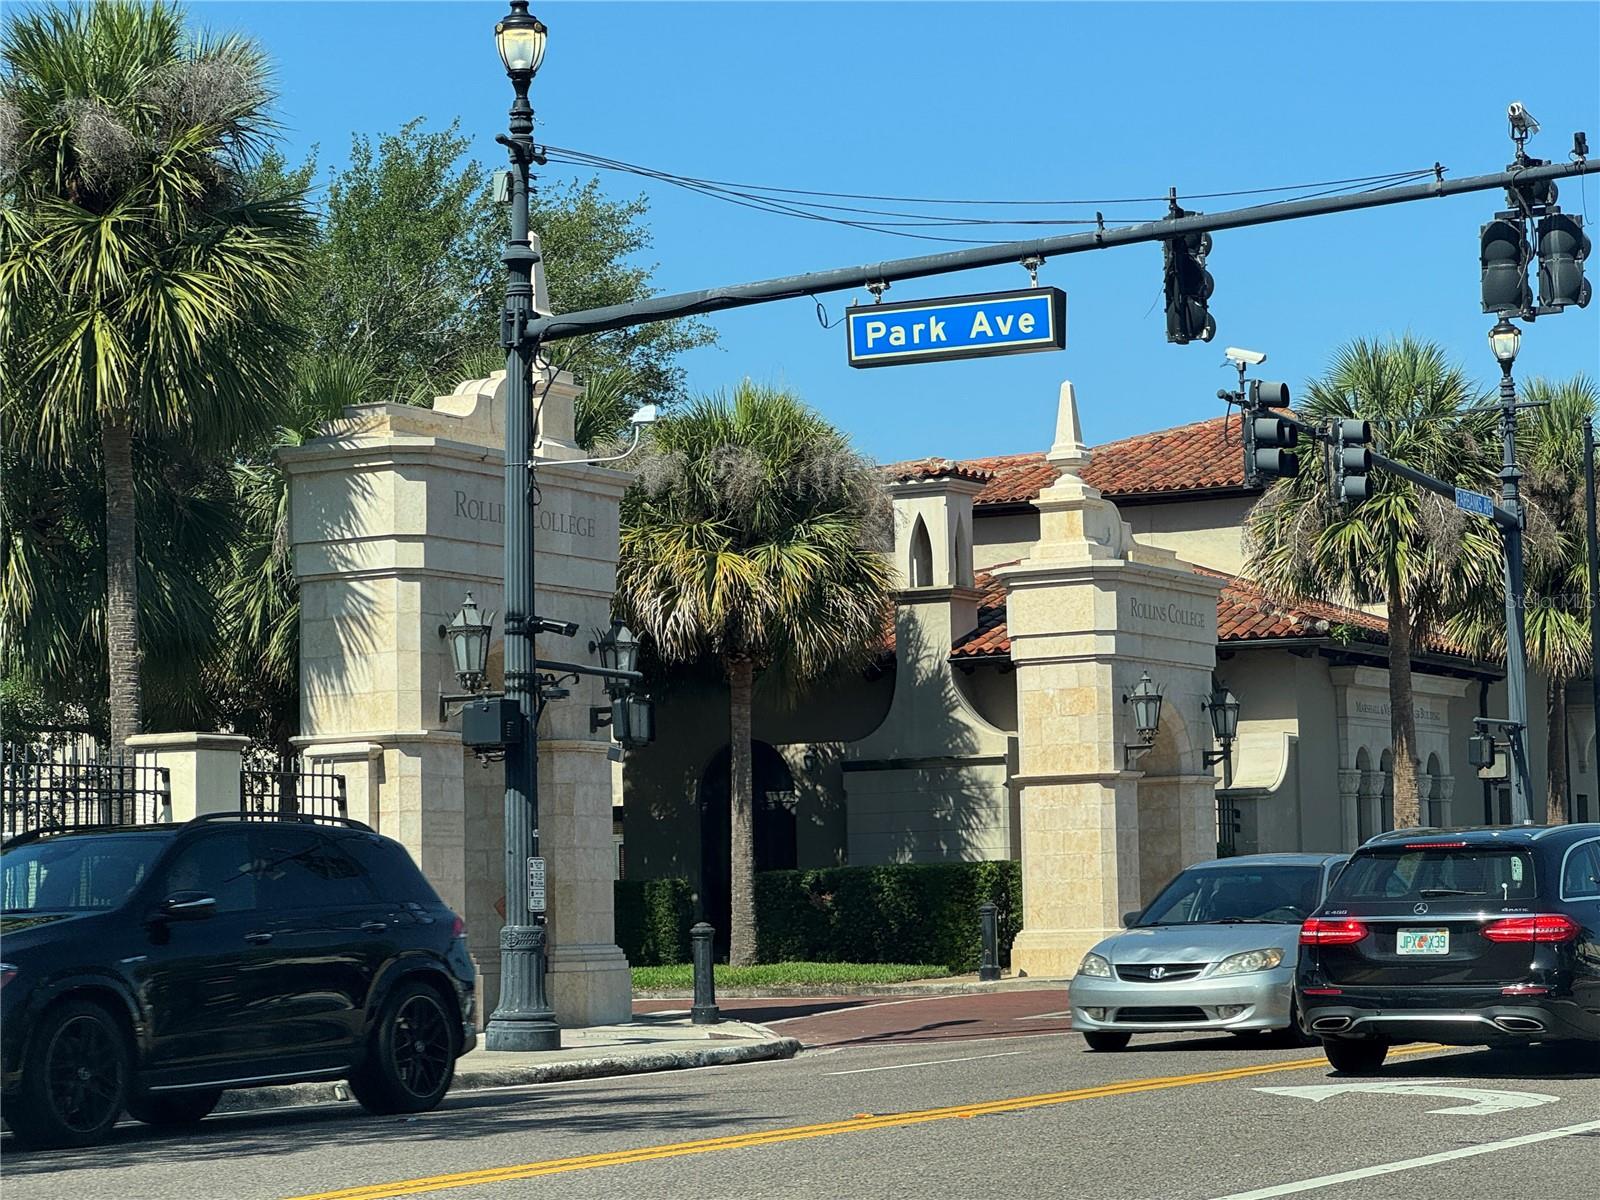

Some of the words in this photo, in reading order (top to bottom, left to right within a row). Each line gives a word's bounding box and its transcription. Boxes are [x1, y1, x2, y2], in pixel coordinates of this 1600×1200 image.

[865, 315, 947, 348] Park
[969, 310, 1036, 339] Ave
[453, 489, 505, 525] ROLLI
